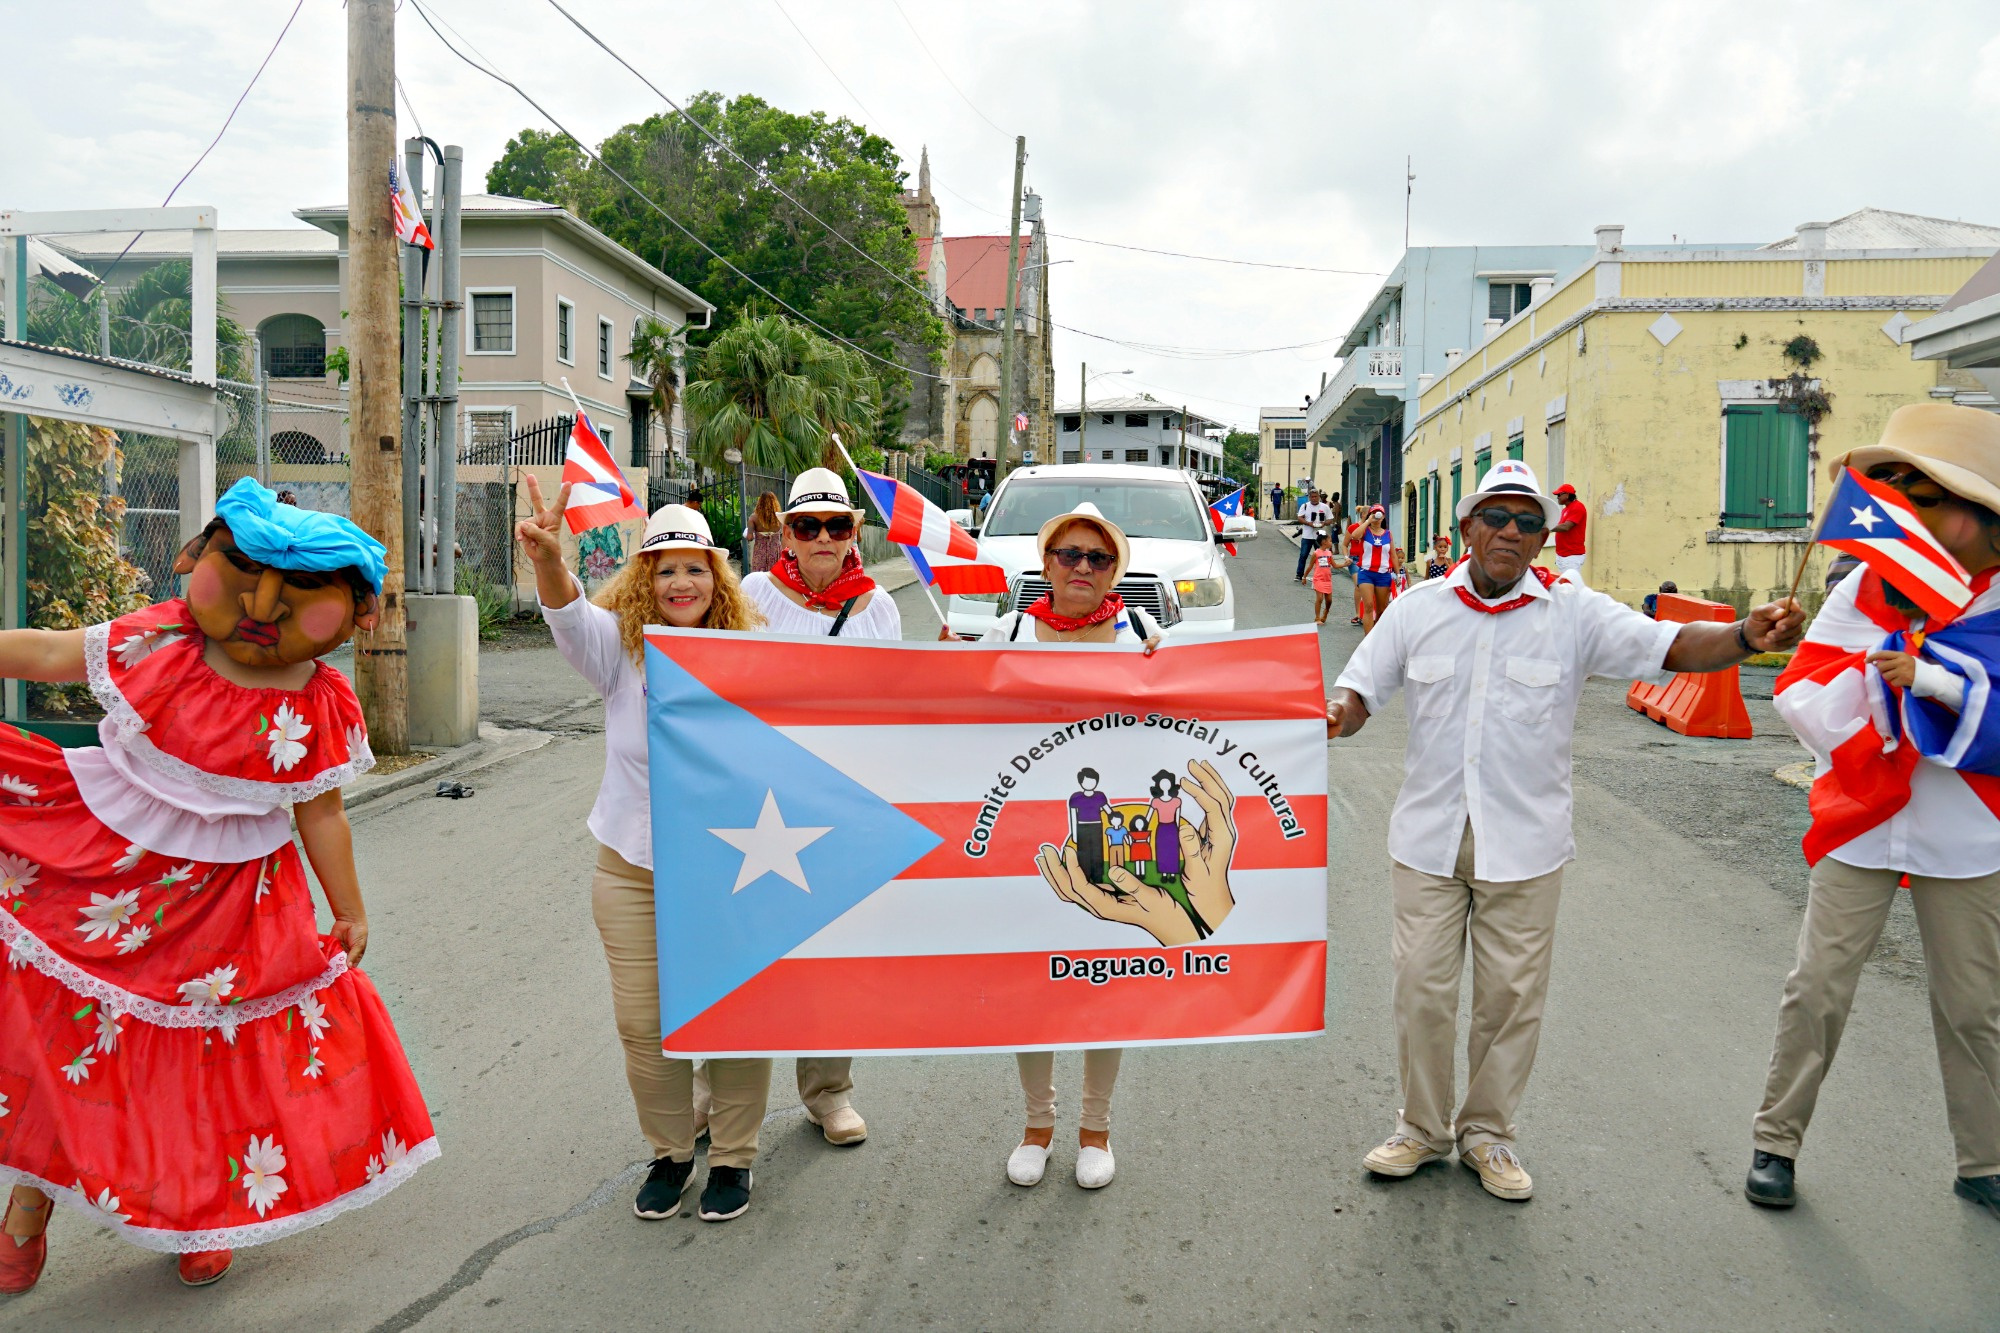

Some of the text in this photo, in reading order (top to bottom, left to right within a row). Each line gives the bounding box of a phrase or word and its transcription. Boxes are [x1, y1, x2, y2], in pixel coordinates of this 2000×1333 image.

[795, 493, 842, 505] PUERTO RICO
[674, 532, 695, 540] RICO
[965, 712, 1305, 857] Comité Desarrollo Social y Cultural
[1049, 951, 1230, 984] Daguao, Inc
